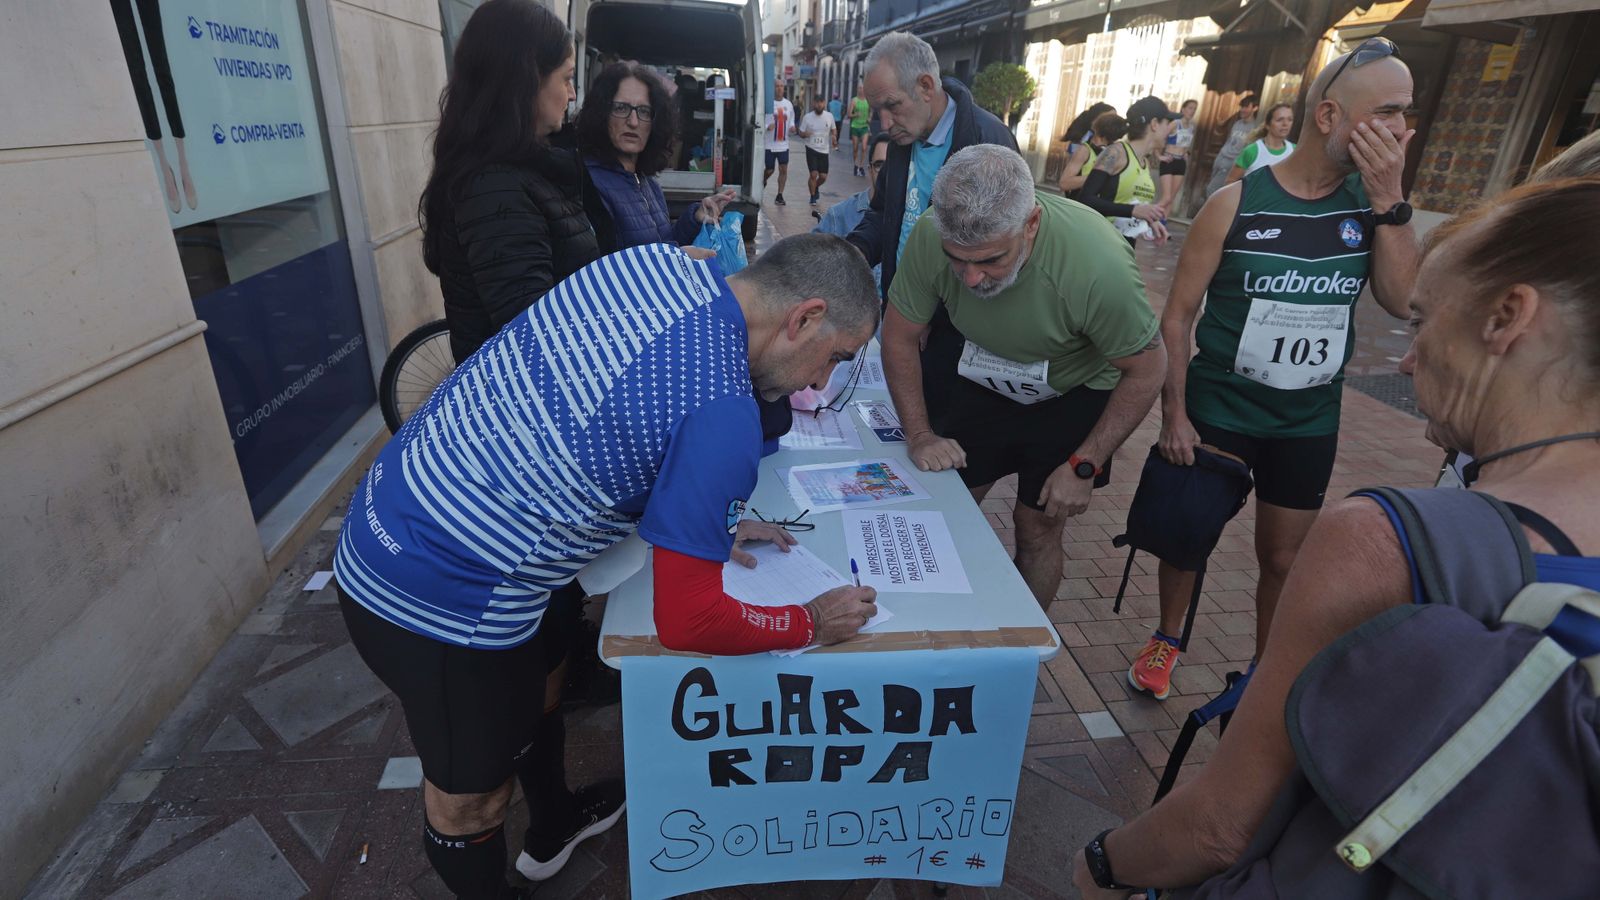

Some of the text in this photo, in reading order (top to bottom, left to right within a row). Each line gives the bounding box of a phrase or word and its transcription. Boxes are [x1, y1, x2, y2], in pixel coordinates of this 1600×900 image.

[206, 20, 279, 50] TRAMITACIÓN
[214, 57, 292, 81] VIVIENDAS VPO
[230, 123, 305, 144] COMPRA-VENTA
[1243, 270, 1364, 295] Ladbrokes
[1267, 336, 1329, 366] 103
[236, 403, 271, 437] GRUPO
[271, 363, 325, 411] INMOBILIARIO
[860, 520, 881, 575] IMPRESCINDIBLE
[876, 513, 903, 584] MOSTRAR EL DORSAL
[893, 516, 921, 581] PARA RECOGER SUS
[911, 523, 937, 573] PERTENENCIAS
[670, 666, 978, 741] GUARDA
[708, 741, 932, 787] ROPA
